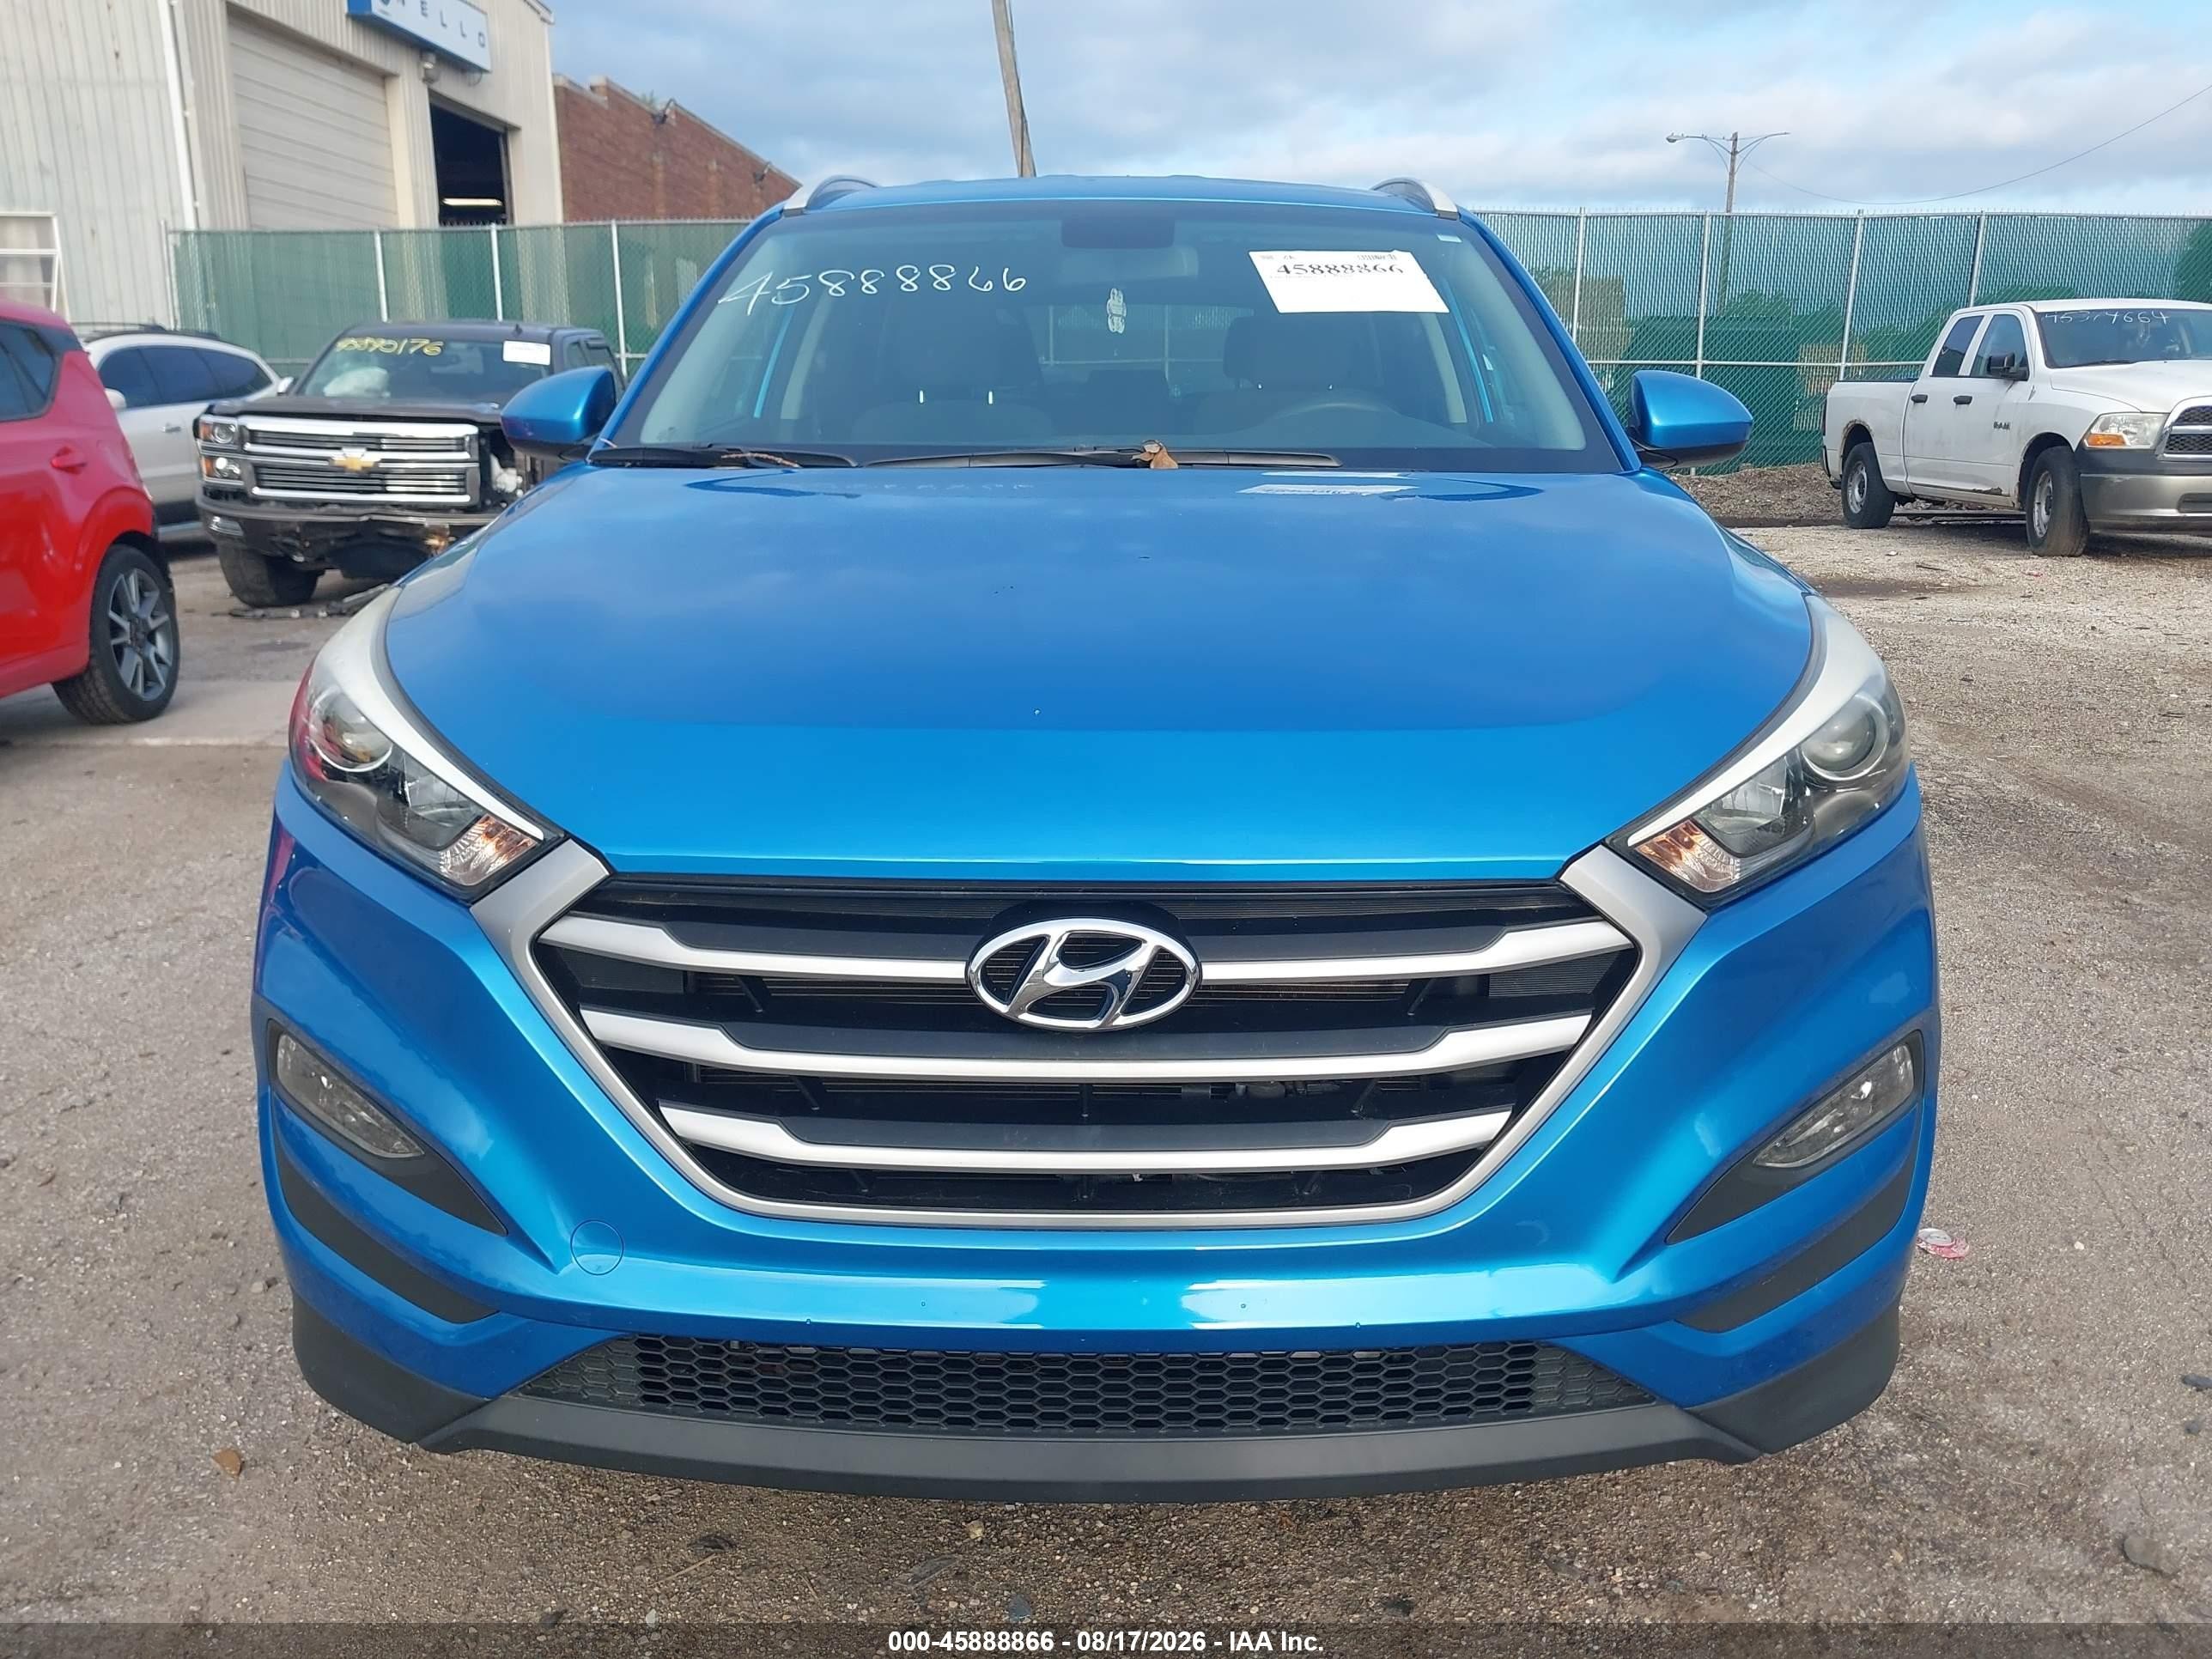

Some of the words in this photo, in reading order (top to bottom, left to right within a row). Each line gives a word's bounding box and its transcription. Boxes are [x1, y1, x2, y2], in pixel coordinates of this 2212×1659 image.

[398, 0, 486, 48] ELLO
[718, 264, 1027, 316] 45888866
[1277, 264, 1404, 275] 45888866
